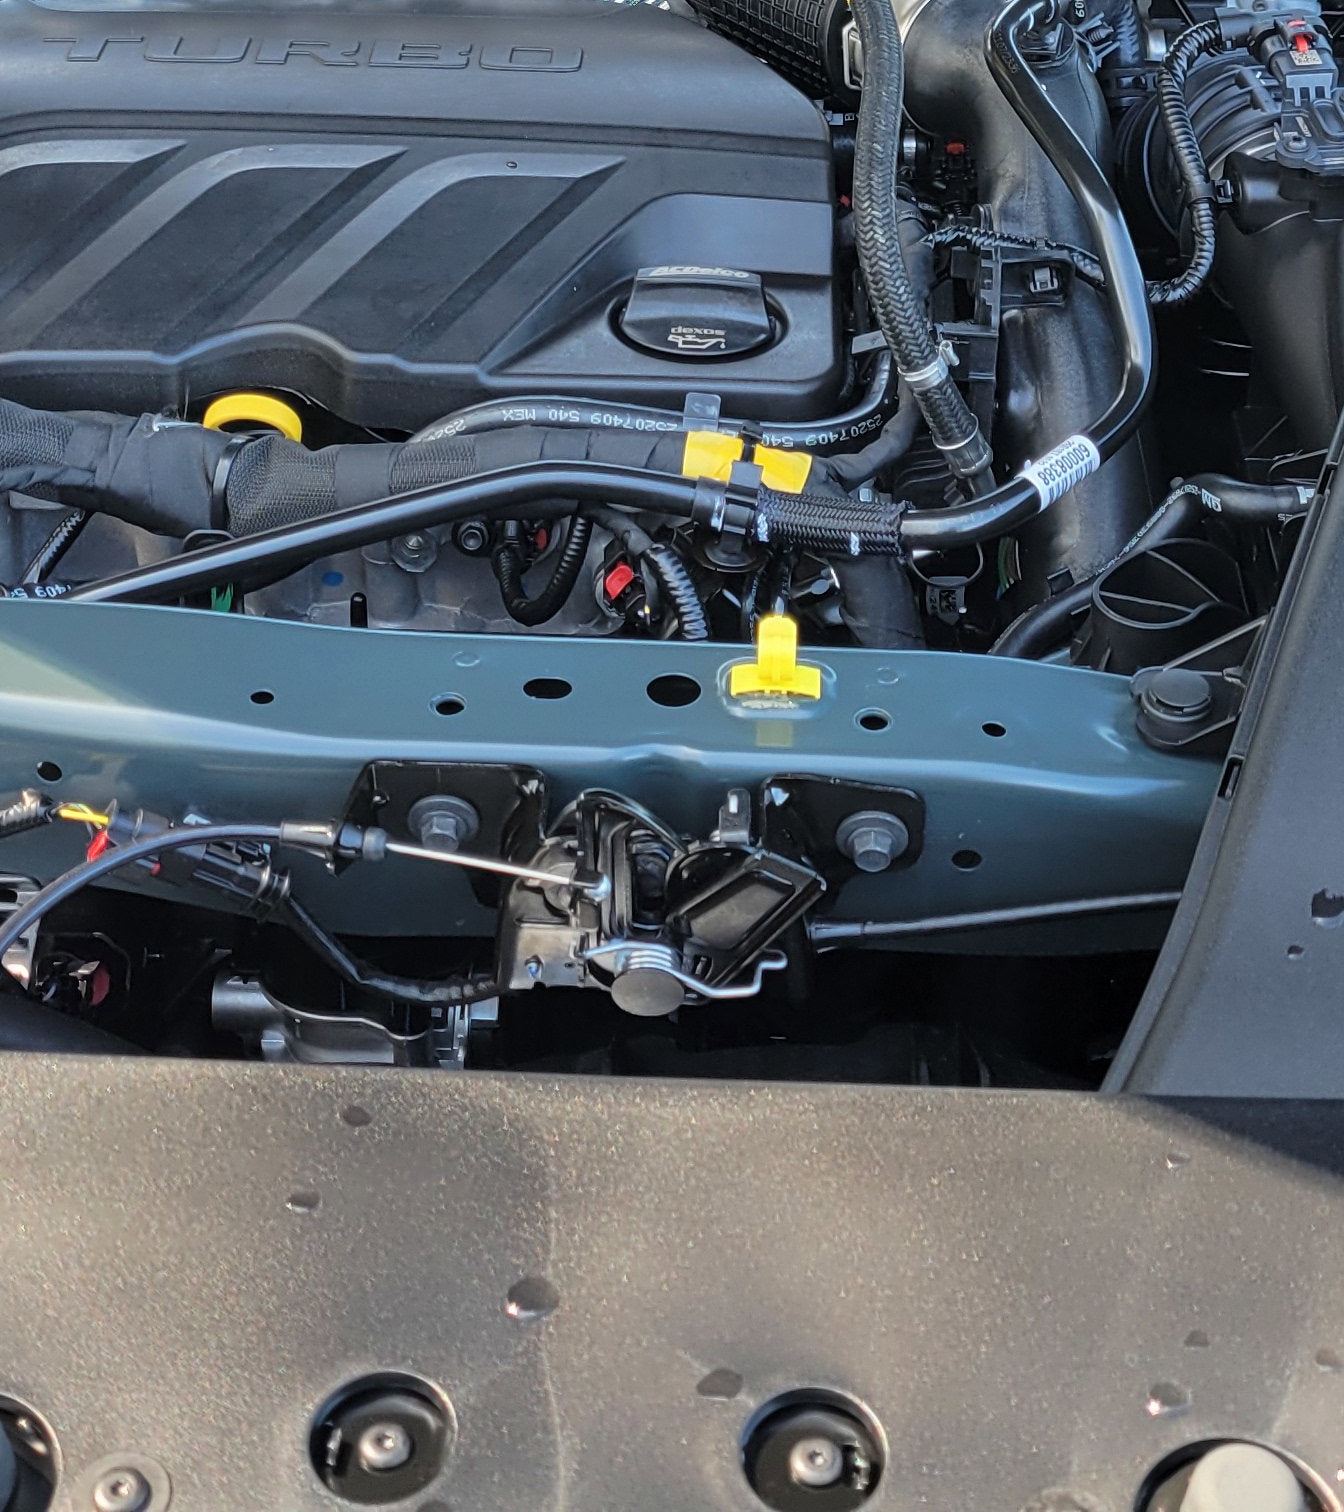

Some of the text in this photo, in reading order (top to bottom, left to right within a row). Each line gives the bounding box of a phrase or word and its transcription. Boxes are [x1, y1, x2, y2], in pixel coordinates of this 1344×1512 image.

[42, 36, 584, 73] TURBO
[670, 325, 726, 335] dexos
[502, 408, 536, 422] MEX
[548, 408, 580, 423] 540
